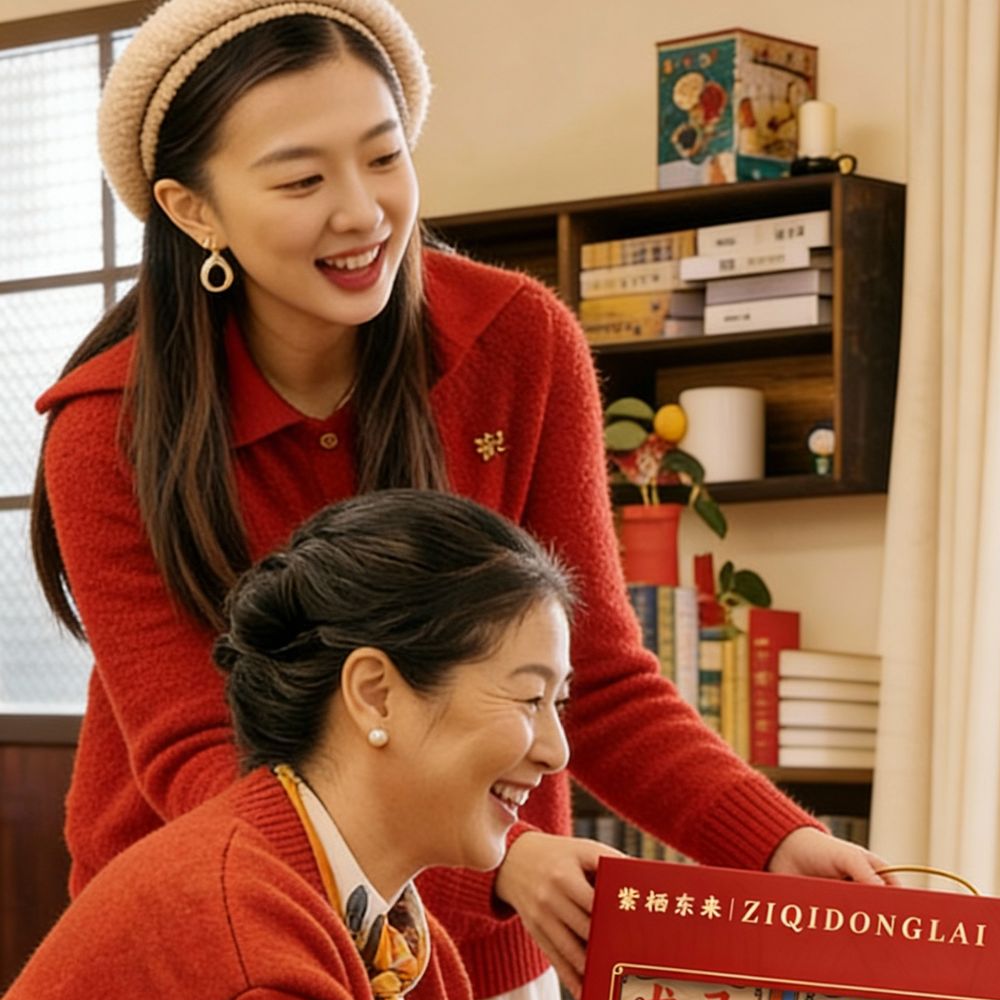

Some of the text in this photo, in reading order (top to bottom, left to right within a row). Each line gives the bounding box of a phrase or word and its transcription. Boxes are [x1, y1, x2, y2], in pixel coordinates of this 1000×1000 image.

[617, 886, 987, 947] 紫栖东来 ZIQIDONGLAI
